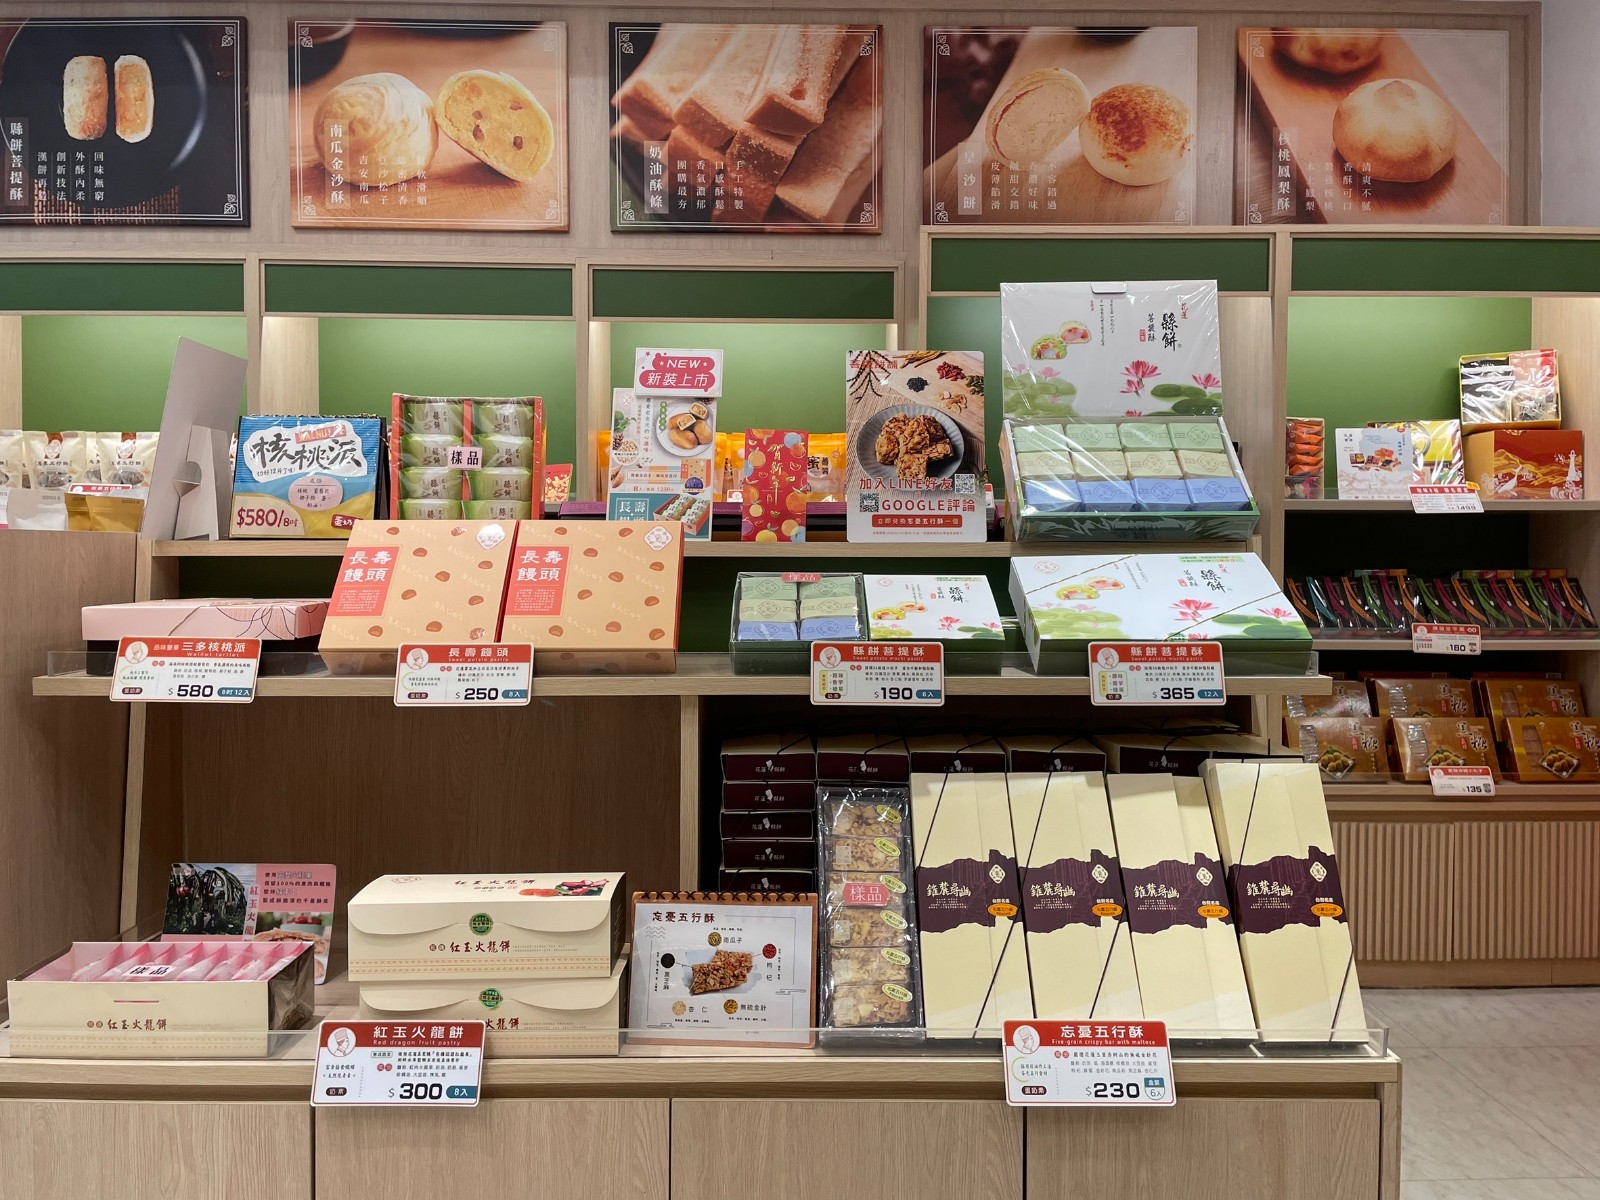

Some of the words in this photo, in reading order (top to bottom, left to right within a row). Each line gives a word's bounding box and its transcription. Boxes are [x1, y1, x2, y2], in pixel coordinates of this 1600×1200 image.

[10, 122, 23, 200] 縣餅菩提酥
[330, 124, 344, 204] 南瓜金沙酥
[56, 152, 67, 200] 創新技法
[75, 152, 86, 200] 外酥內柔
[94, 152, 104, 200] 回味無窮
[649, 146, 662, 209] 奶油酥條
[1277, 132, 1291, 211] 核桃鳳梨酥
[696, 160, 706, 209] 香氣濃郁
[714, 161, 725, 210] 口感酥鬆
[733, 160, 744, 210] 手工特製
[1047, 162, 1057, 210] 不容錯過
[1342, 162, 1353, 210] 香酥可口
[1361, 162, 1372, 211] 清爽不膩
[1161, 312, 1179, 351] 縣餅
[666, 360, 701, 369] NEW
[646, 372, 709, 387] 新裝上市
[252, 432, 362, 470] 核桃派
[451, 450, 479, 466] 樣品
[860, 476, 954, 491] 加入LINE好友
[619, 501, 646, 513] 長壽
[881, 499, 975, 512] GOOGLE評論
[334, 516, 355, 528] 蛋奶
[349, 550, 392, 565] 長壽
[520, 550, 564, 564] 長壽
[343, 567, 389, 583] 饅頭
[516, 567, 562, 582] 饅頭
[181, 641, 246, 653] 三多核桃派
[448, 647, 509, 657] 長壽饅頭
[853, 646, 925, 656] 縣餅菩提酥
[1130, 646, 1203, 656] 縣餅菩提酥
[1450, 644, 1466, 652] 180
[849, 885, 883, 902] 樣品
[244, 885, 260, 942] 紅玉火龍
[652, 911, 715, 924] 忘憂五行酥
[450, 940, 511, 954] 紅玉火龍餅
[130, 966, 172, 976] 樣品
[107, 1018, 168, 1031] 紅玉火龍餅
[485, 1017, 520, 1030] 火龍餅
[373, 1025, 465, 1039] 紅玉火龍餅
[1060, 1025, 1144, 1039] 忘憂五行酥
[389, 1039, 416, 1047] dragon
[388, 1082, 443, 1100] $300
[453, 1088, 469, 1097] 8入
[1086, 1082, 1140, 1099] $230
[1150, 1089, 1162, 1097] 6入
